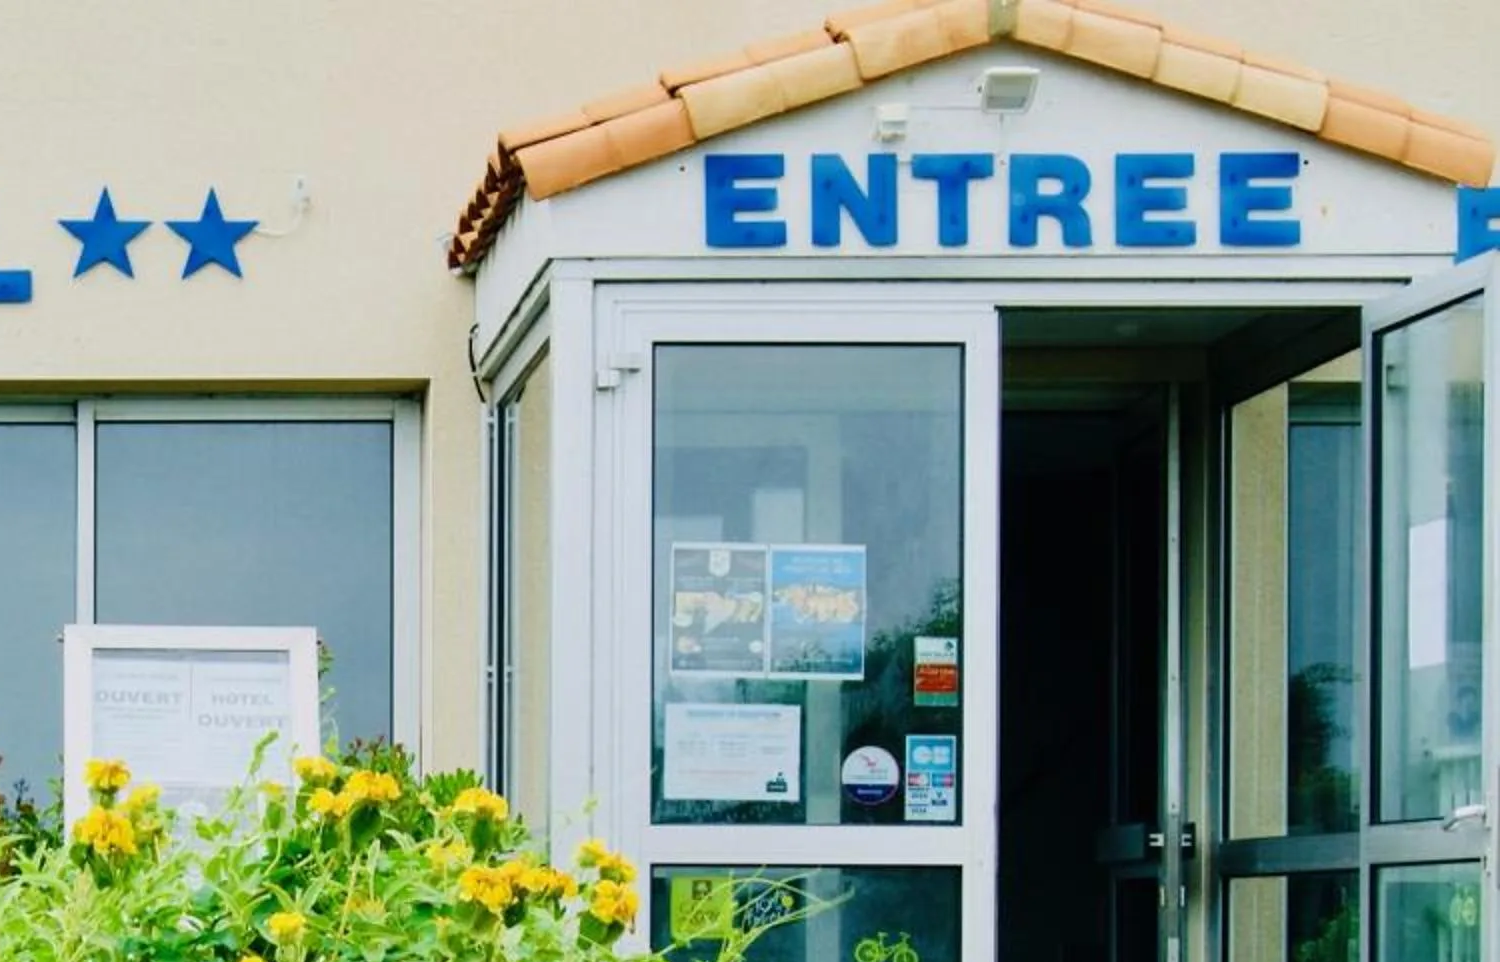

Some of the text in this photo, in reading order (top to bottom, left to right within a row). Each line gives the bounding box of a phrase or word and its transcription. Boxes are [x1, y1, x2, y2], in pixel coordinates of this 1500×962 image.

[704, 152, 1300, 248] ENTREE
[95, 688, 182, 705] OUVERT
[198, 713, 287, 728] OUVERT
